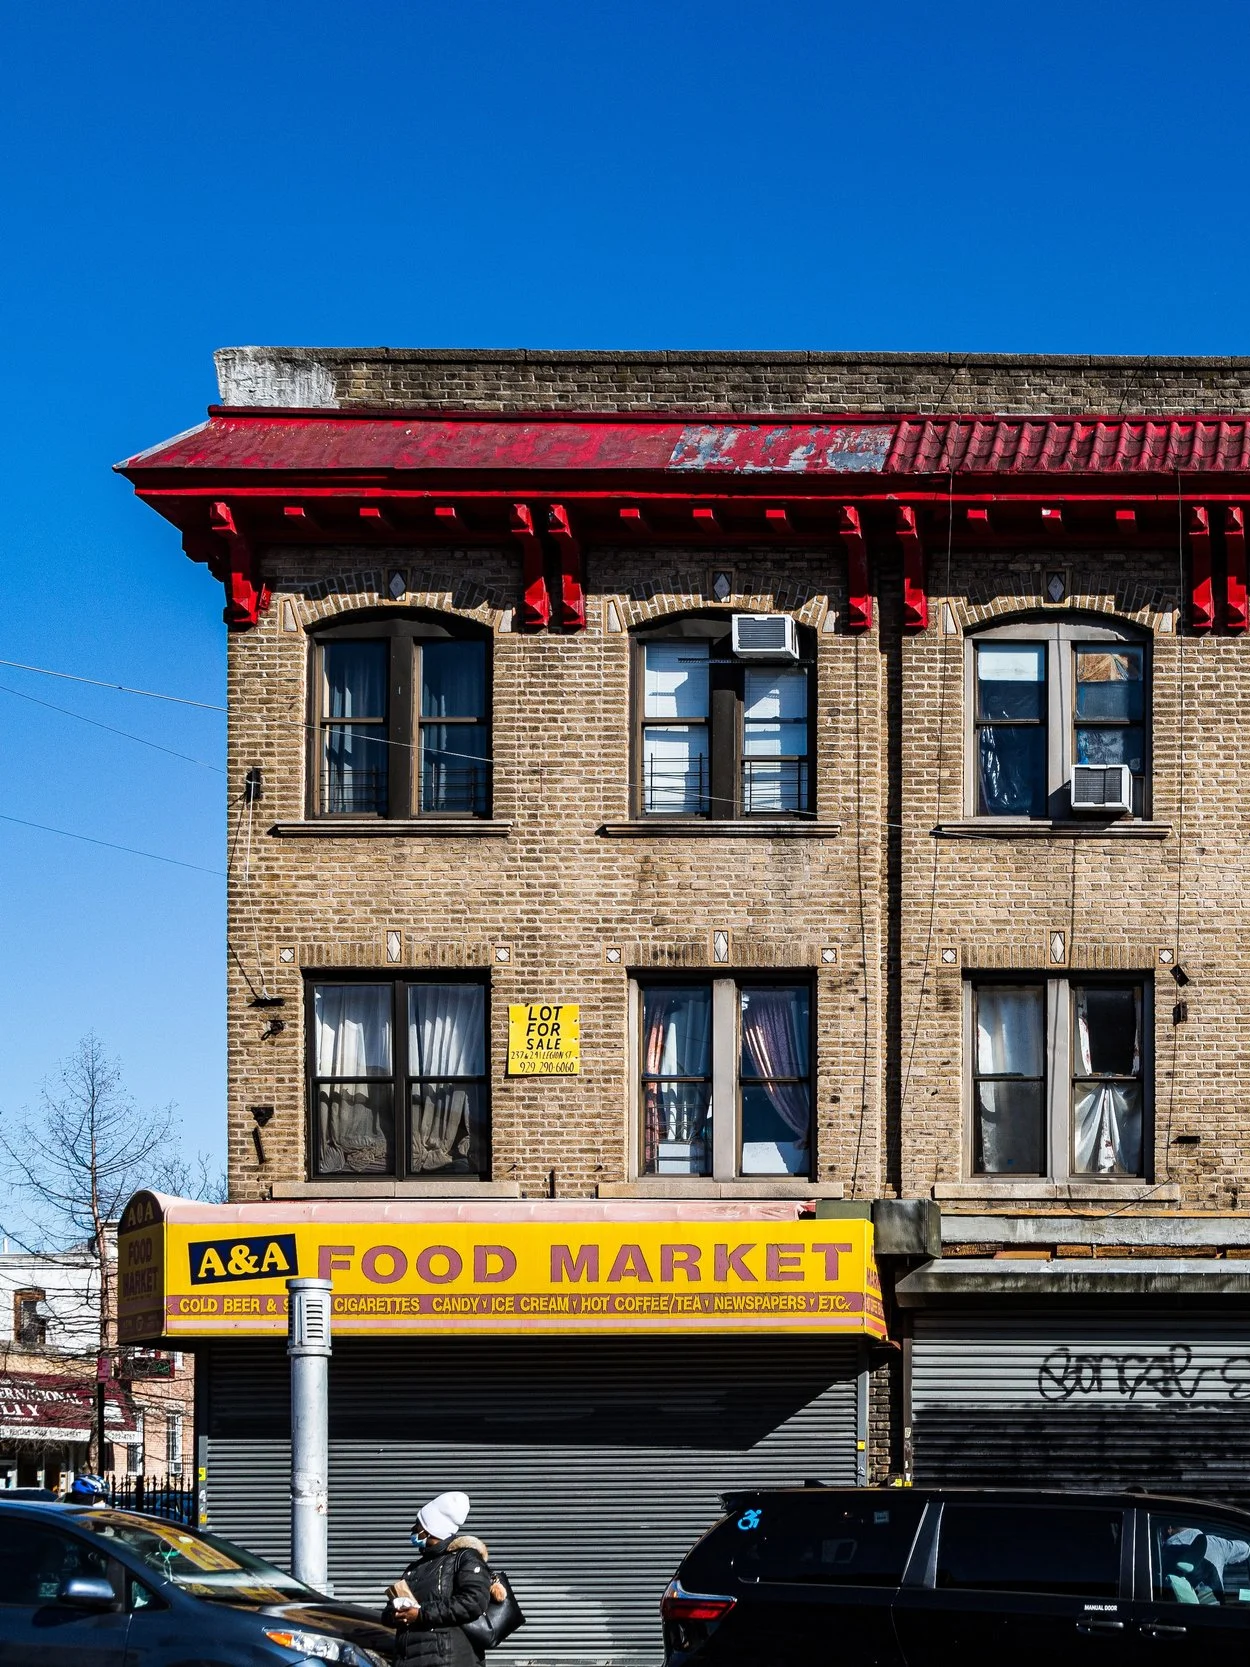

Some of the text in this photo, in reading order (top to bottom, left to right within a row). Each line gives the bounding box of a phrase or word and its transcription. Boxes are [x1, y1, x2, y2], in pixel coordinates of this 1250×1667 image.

[528, 1006, 563, 1021] LOT
[526, 1022, 560, 1037] FOR
[526, 1038, 561, 1050] SALE
[520, 1062, 574, 1073] 929 290-6060
[128, 1237, 153, 1267] FOOD
[198, 1242, 290, 1278] A&A
[318, 1245, 517, 1284] FOOD
[550, 1243, 853, 1283] MARKET
[122, 1266, 158, 1298] MARKET
[179, 1298, 218, 1313] COLD
[223, 1298, 260, 1313] BEER
[266, 1298, 277, 1312] &
[334, 1297, 420, 1313] CIGARETTES
[432, 1297, 479, 1312] CANDY
[491, 1297, 515, 1312] ICE
[520, 1297, 570, 1312] CREAM
[581, 1297, 609, 1312] HOT
[614, 1296, 702, 1314] COFFEE/TEA
[714, 1297, 806, 1312] NEWSPAPERS
